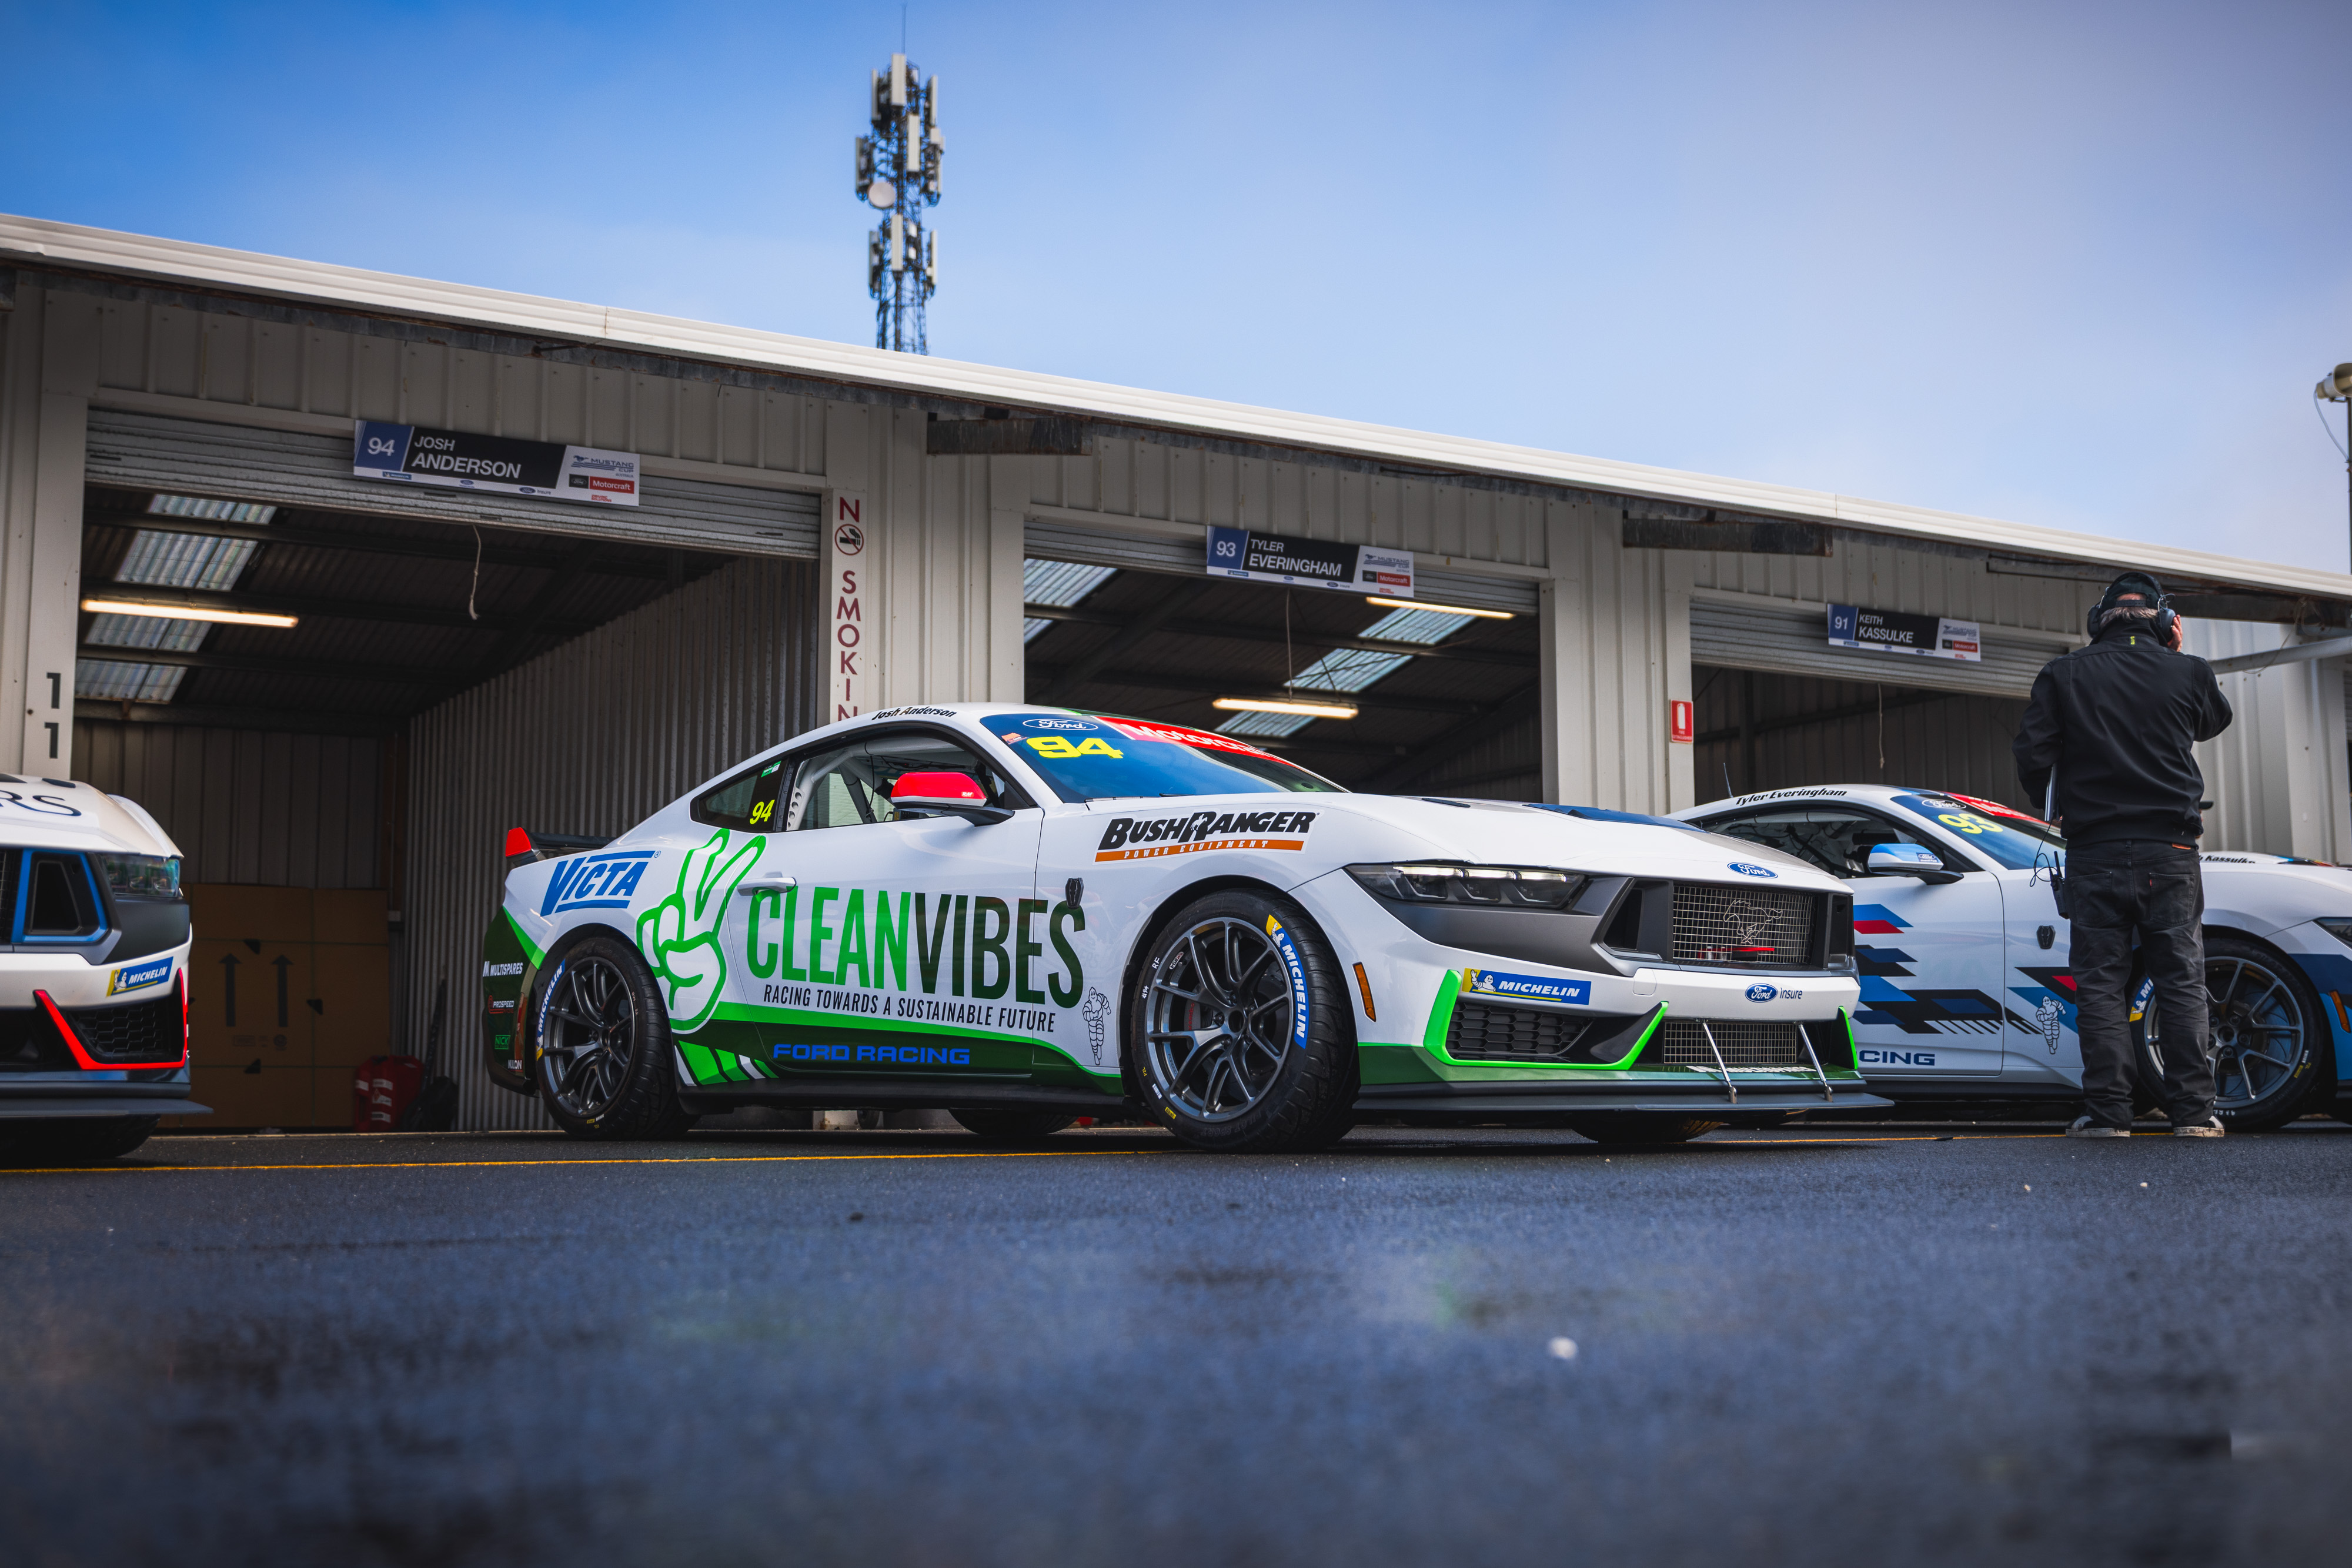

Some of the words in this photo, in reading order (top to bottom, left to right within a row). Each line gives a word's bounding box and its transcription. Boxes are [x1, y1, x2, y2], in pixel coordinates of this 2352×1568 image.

[368, 437, 395, 456] 94
[414, 436, 456, 452] JOSH
[411, 453, 522, 479] ANDERSON
[591, 458, 634, 468] MUSTANG
[593, 480, 632, 491] Motorcraft
[1216, 541, 1237, 557] 93
[1250, 539, 1285, 553] TYLER
[1248, 553, 1342, 577] EVERINGHAM
[1379, 575, 1408, 583] Motorcraft
[1834, 616, 1848, 630] 91
[1859, 614, 1883, 626] KEITH
[1859, 627, 1914, 643] KASSULKE
[871, 707, 901, 721] Josh
[899, 706, 957, 717] Anderson
[1038, 720, 1087, 730] Ford
[1026, 736, 1124, 758] 94
[1736, 794, 1769, 806] Tyler
[1769, 788, 1847, 799] Everingham
[750, 800, 775, 824] 94
[1938, 813, 2003, 834] 93
[1124, 847, 1170, 860] POWER
[1179, 840, 1269, 853] EQUIPMENT
[1739, 864, 1770, 878] Ford
[540, 857, 649, 917] VICTA
[128, 966, 168, 985] MICHELIN
[490, 962, 523, 976] MULTISPARES
[1282, 944, 1306, 1039] MICHELIN
[1499, 980, 1581, 998] MICHELIN
[1750, 987, 1773, 999] Ford
[1780, 987, 1803, 999] Insure
[538, 965, 563, 1033] MICHELIN
[763, 984, 811, 1007] RACING
[816, 989, 878, 1014] TOWARDS
[883, 997, 892, 1015] A
[897, 998, 993, 1027] SUSTAINABLE
[998, 1007, 1057, 1033] FUTURE
[495, 1037, 509, 1045] NICK
[773, 1044, 850, 1061] FORD
[857, 1045, 970, 1064] RACING
[1855, 1050, 1935, 1066] CING
[508, 1059, 523, 1070] NULON
